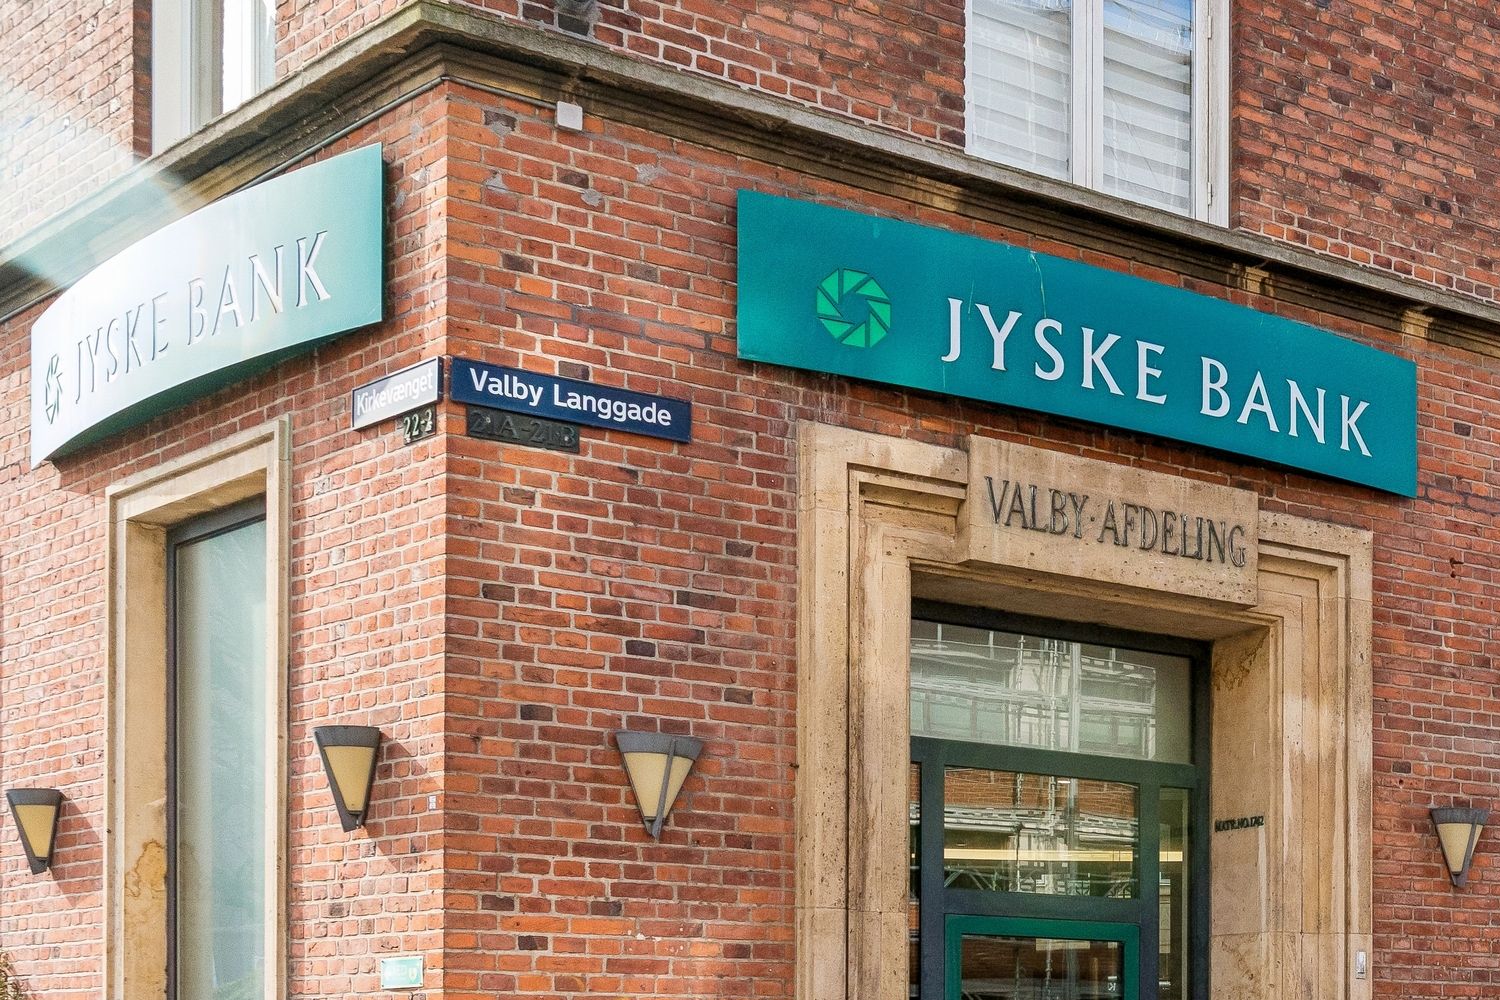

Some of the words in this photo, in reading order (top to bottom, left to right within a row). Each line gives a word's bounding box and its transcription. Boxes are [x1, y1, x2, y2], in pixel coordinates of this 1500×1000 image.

[75, 291, 169, 404] JYSKE
[187, 230, 332, 346] BANK
[356, 367, 433, 415] Kirkevænget
[469, 367, 544, 407] Valby
[553, 383, 673, 427] Langgade
[941, 297, 1168, 405] JYSKE
[1200, 356, 1373, 458] BANK
